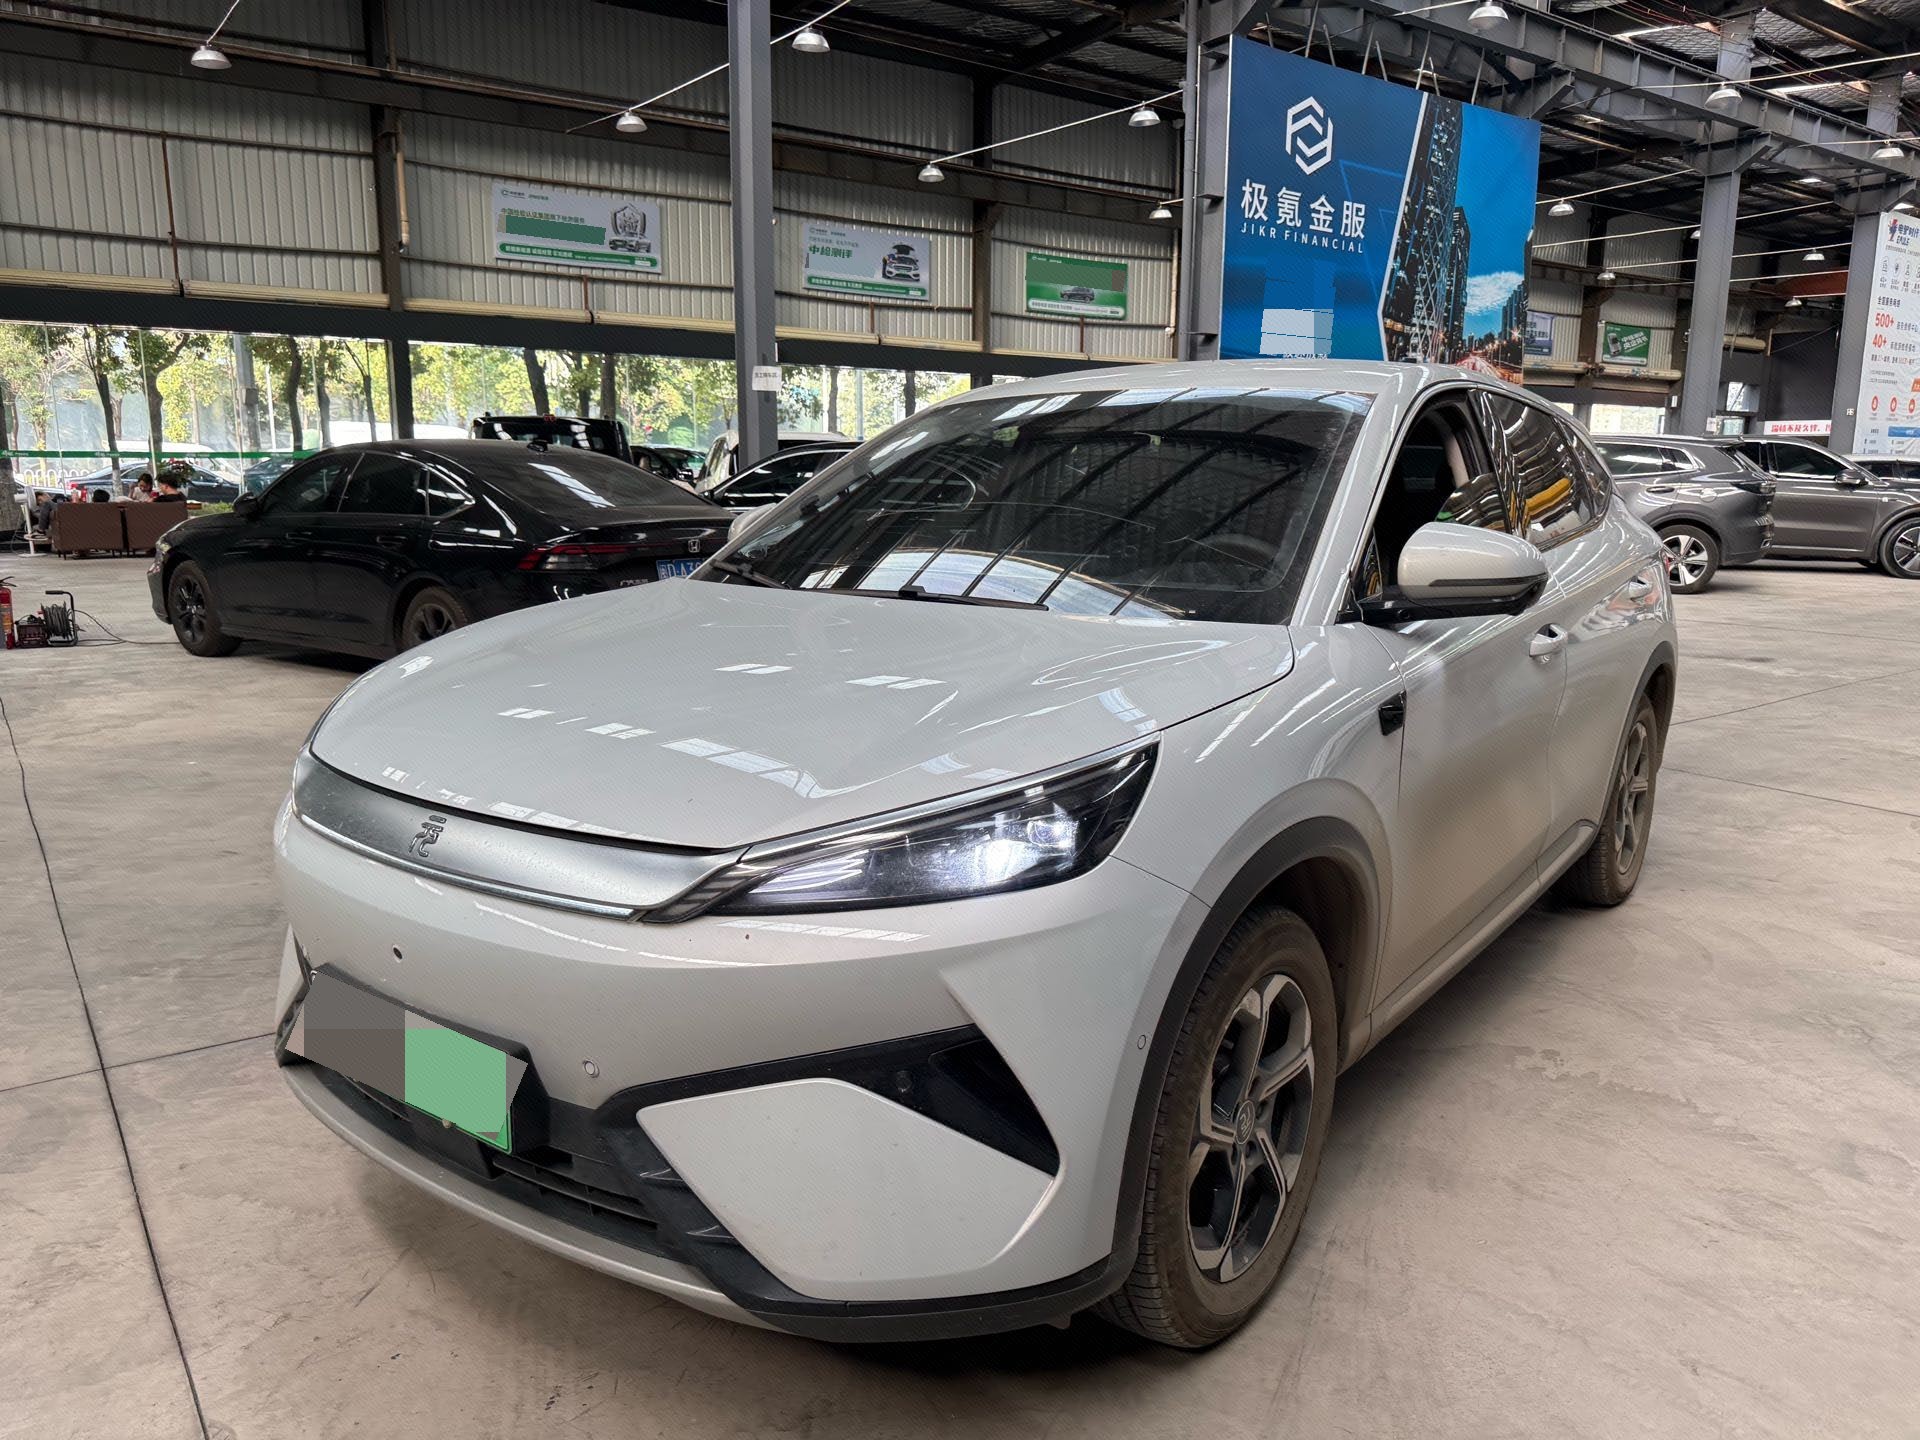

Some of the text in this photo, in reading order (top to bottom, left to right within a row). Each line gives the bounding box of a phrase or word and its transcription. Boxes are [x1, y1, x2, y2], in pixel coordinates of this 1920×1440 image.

[1241, 178, 1366, 240] 极氪金服
[1241, 222, 1363, 254] JIKR FINANCIAL
[1875, 312, 1894, 328] 500+
[1872, 333, 1887, 348] 40+
